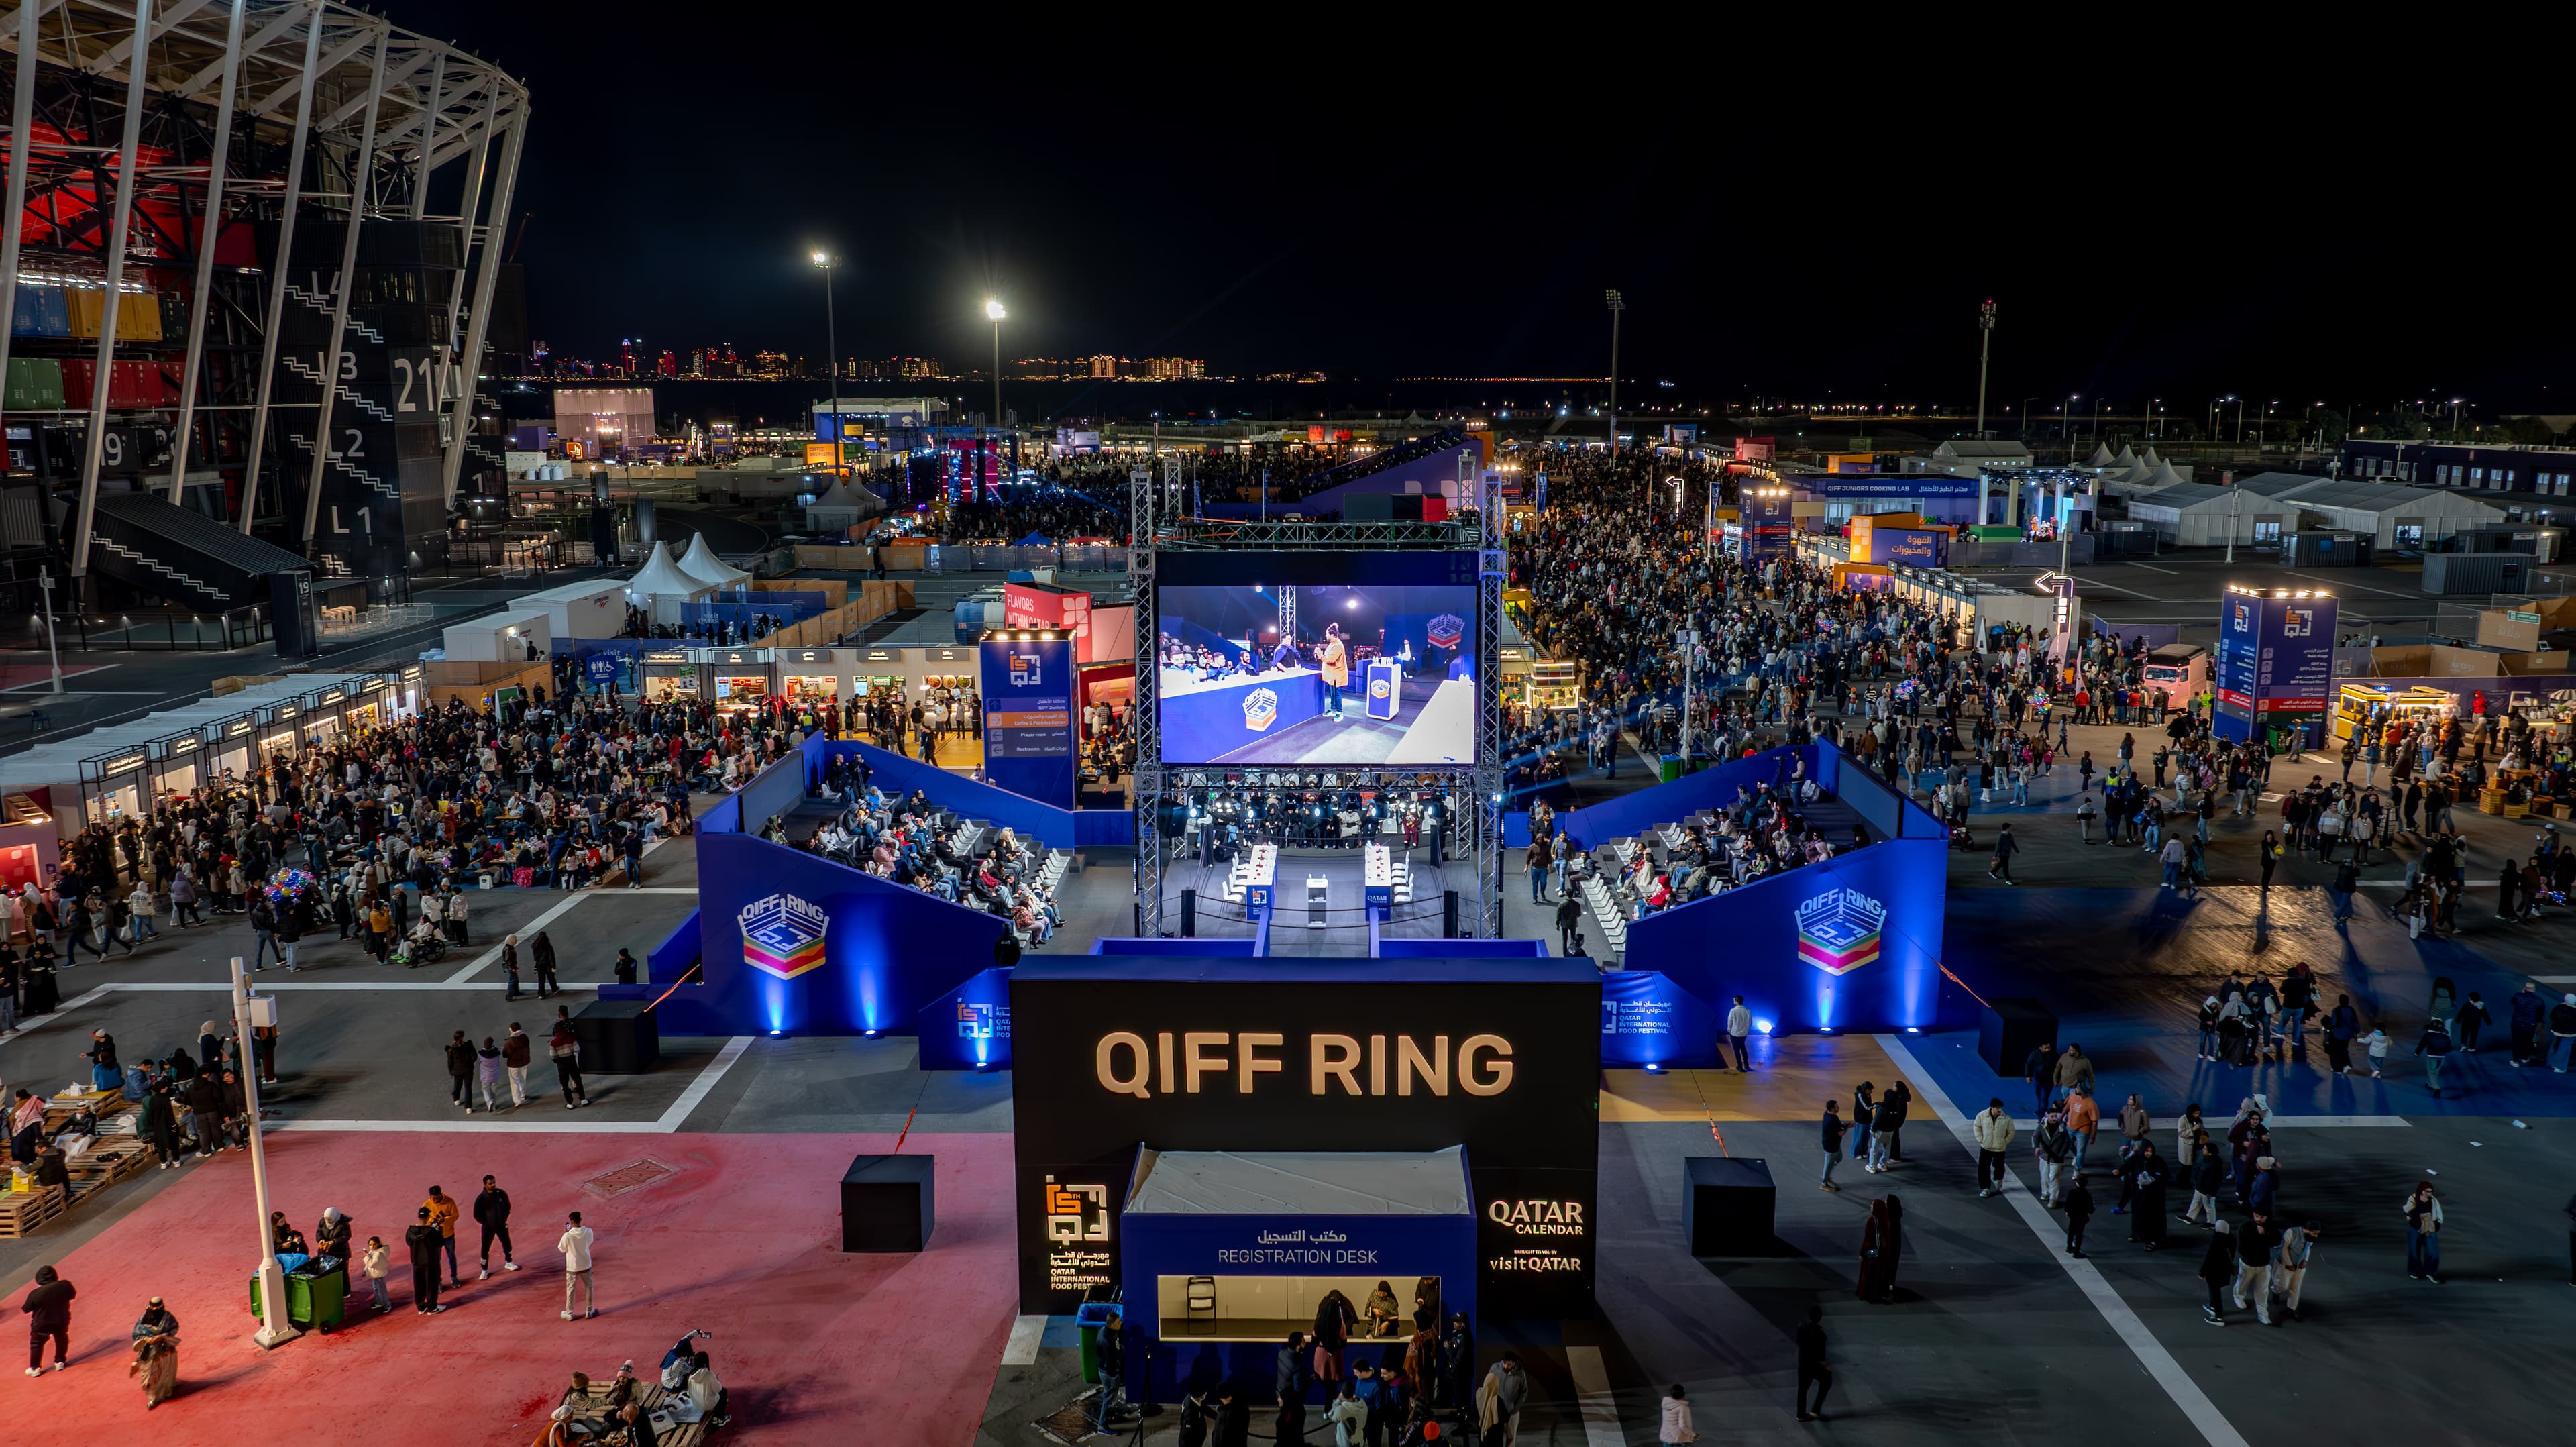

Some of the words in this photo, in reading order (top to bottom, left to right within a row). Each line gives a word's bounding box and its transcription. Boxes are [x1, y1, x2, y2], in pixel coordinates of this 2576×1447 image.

[394, 358, 434, 412] 21
[331, 506, 371, 533] L1
[1907, 536, 1931, 545] القهوة
[1892, 545, 1931, 557] والمخبوزات
[1007, 594, 1034, 612] FLAVORS
[1008, 612, 1028, 629] WITHIN
[1447, 614, 1463, 624] RING
[742, 894, 780, 920] QIFF
[787, 894, 824, 921] RING
[1800, 888, 1839, 914] QIFF
[1846, 888, 1882, 914] RING
[1096, 1031, 1284, 1100] QIFF
[1310, 1033, 1514, 1097] RING
[1489, 1201, 1584, 1226] QATAR
[1258, 1230, 1305, 1244] التسجيل
[1309, 1230, 1347, 1244] مكتب
[1515, 1224, 1584, 1235] CALENDAR
[1218, 1250, 1330, 1263] REGISTRATION
[1336, 1250, 1377, 1263] DESK
